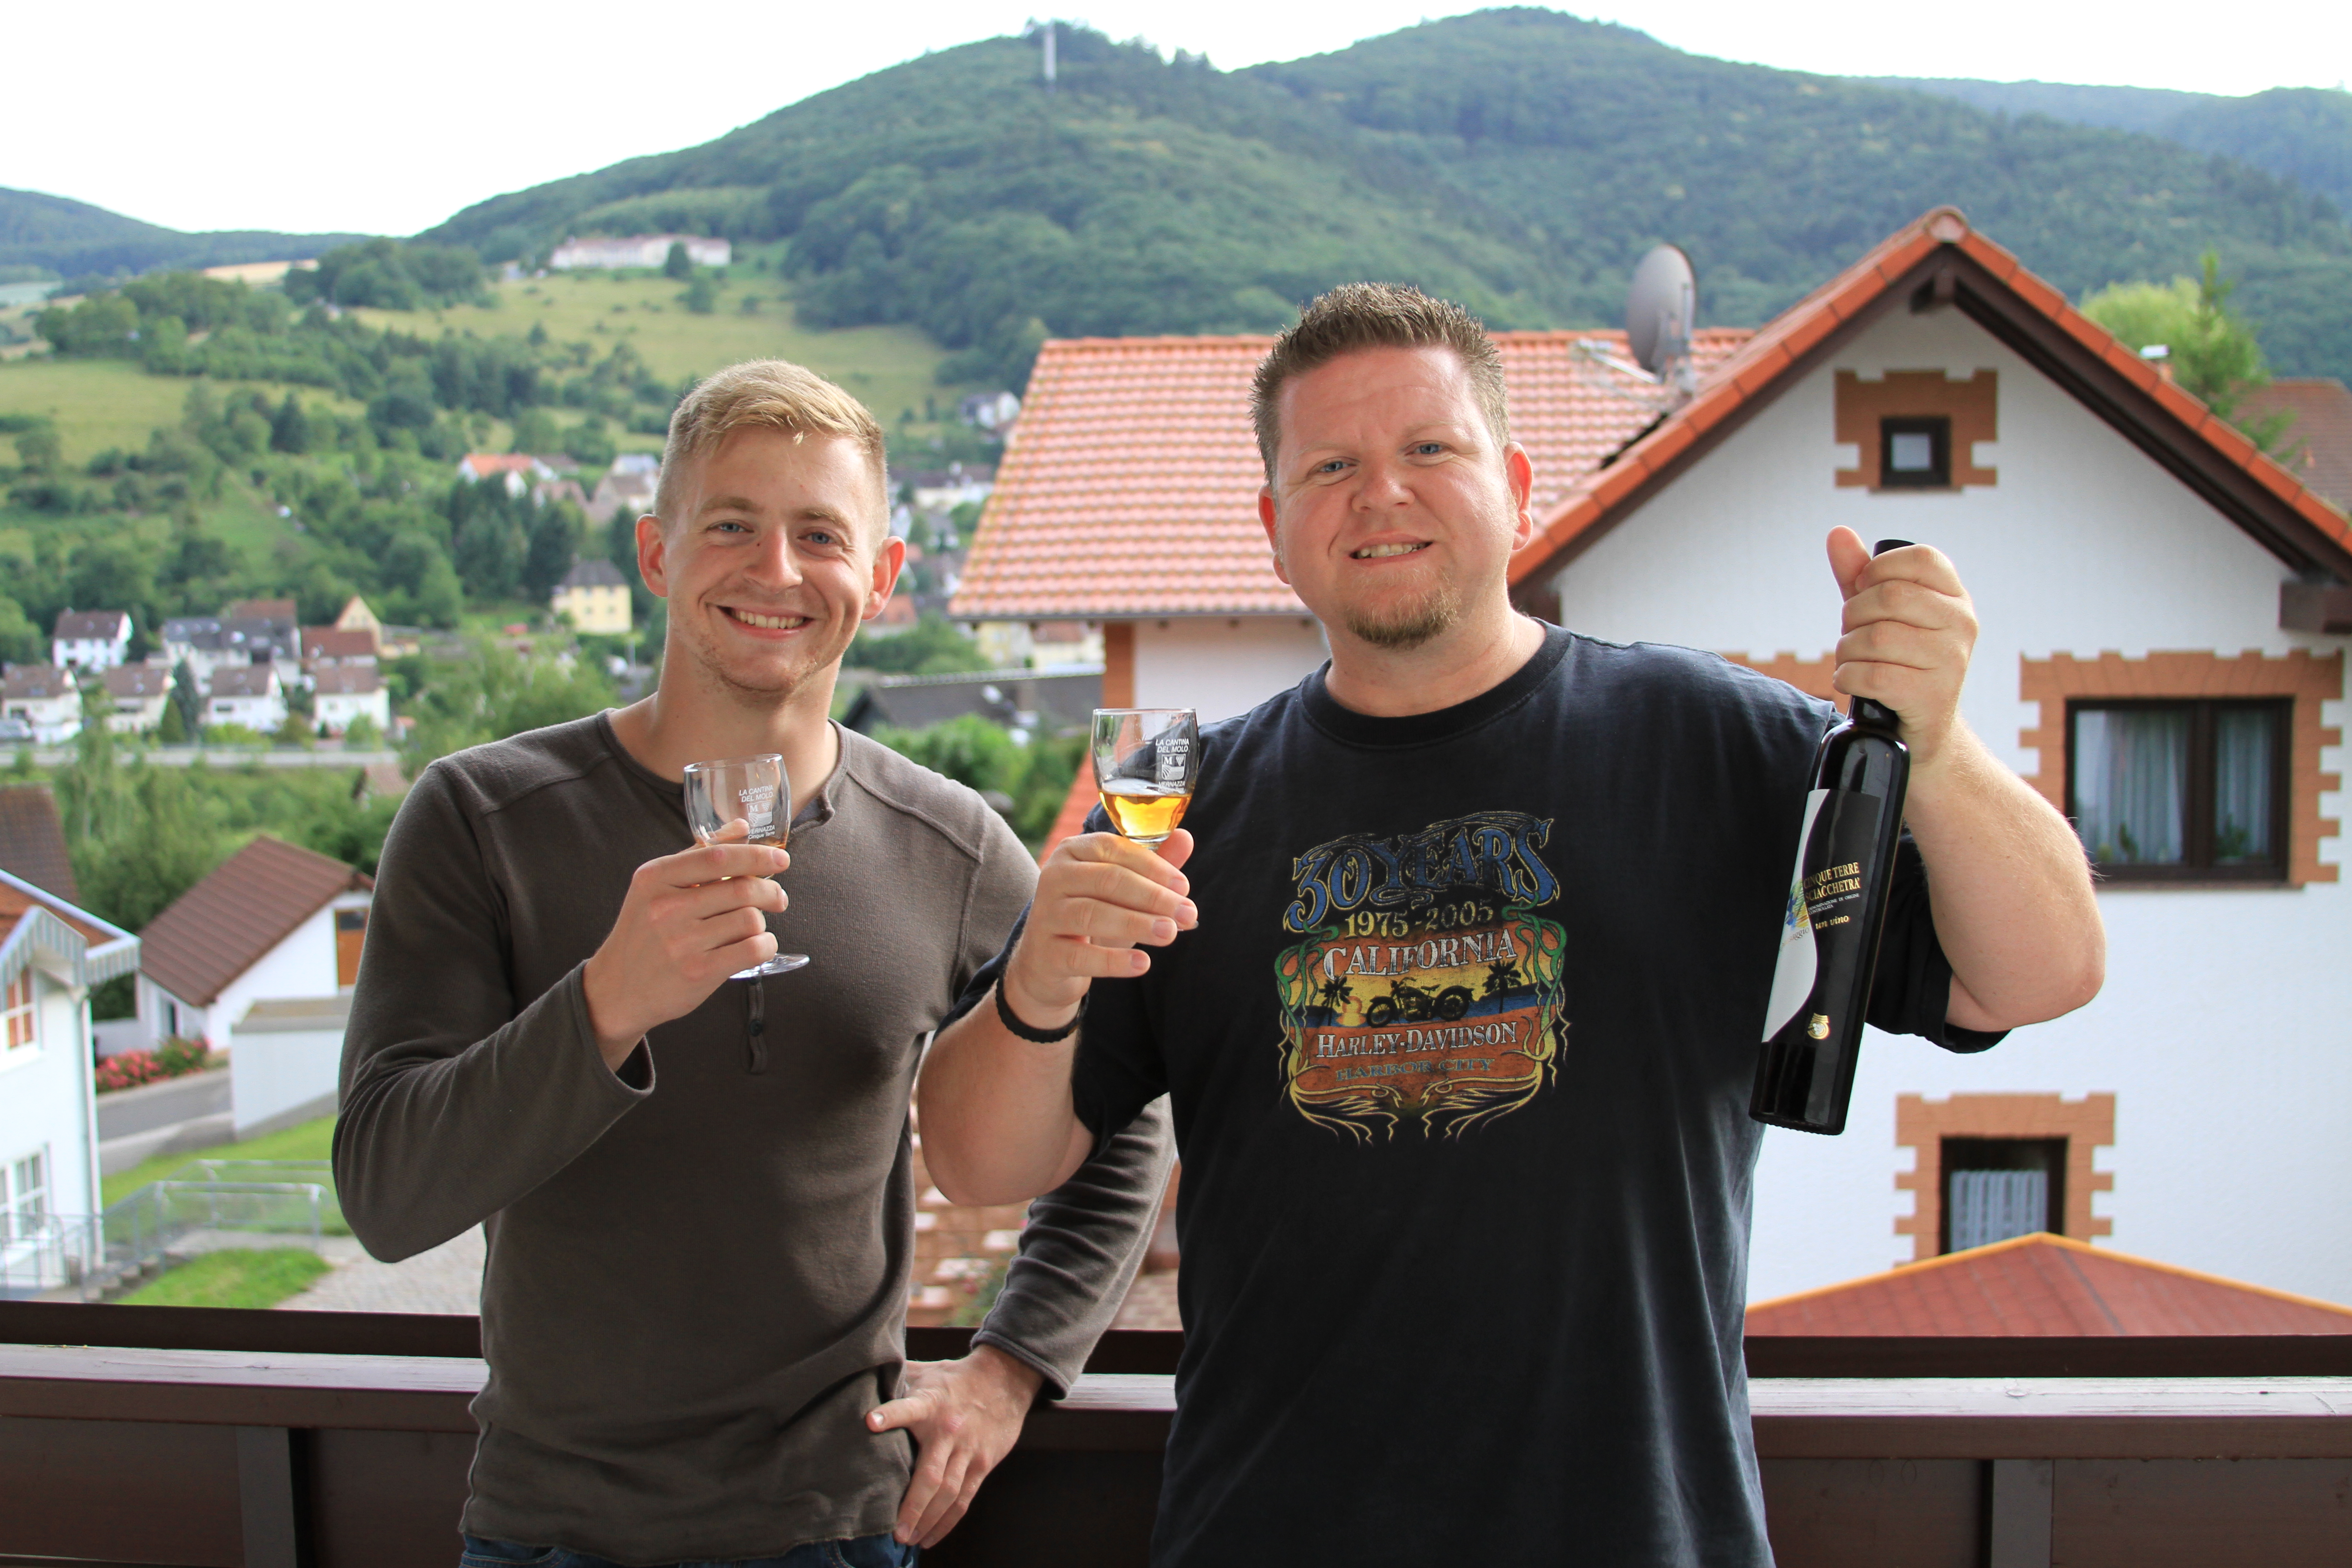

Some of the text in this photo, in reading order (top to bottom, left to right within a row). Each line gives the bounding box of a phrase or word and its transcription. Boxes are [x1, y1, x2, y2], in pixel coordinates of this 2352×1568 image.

[1164, 756, 1173, 765] M
[749, 784, 774, 795] CANTINA
[756, 791, 773, 800] MOLO
[750, 804, 759, 812] M
[749, 825, 775, 834] VERNAZZA
[1283, 818, 1560, 933] 30 YEARS
[1803, 862, 1860, 889] CINQUE TERRE
[1815, 915, 1850, 930] un vino
[1323, 928, 1517, 981] CALIFORNIA
[1316, 1021, 1518, 1058] HARLEY-DAVIDSON
[1335, 1058, 1495, 1082] HARBOR CITY
